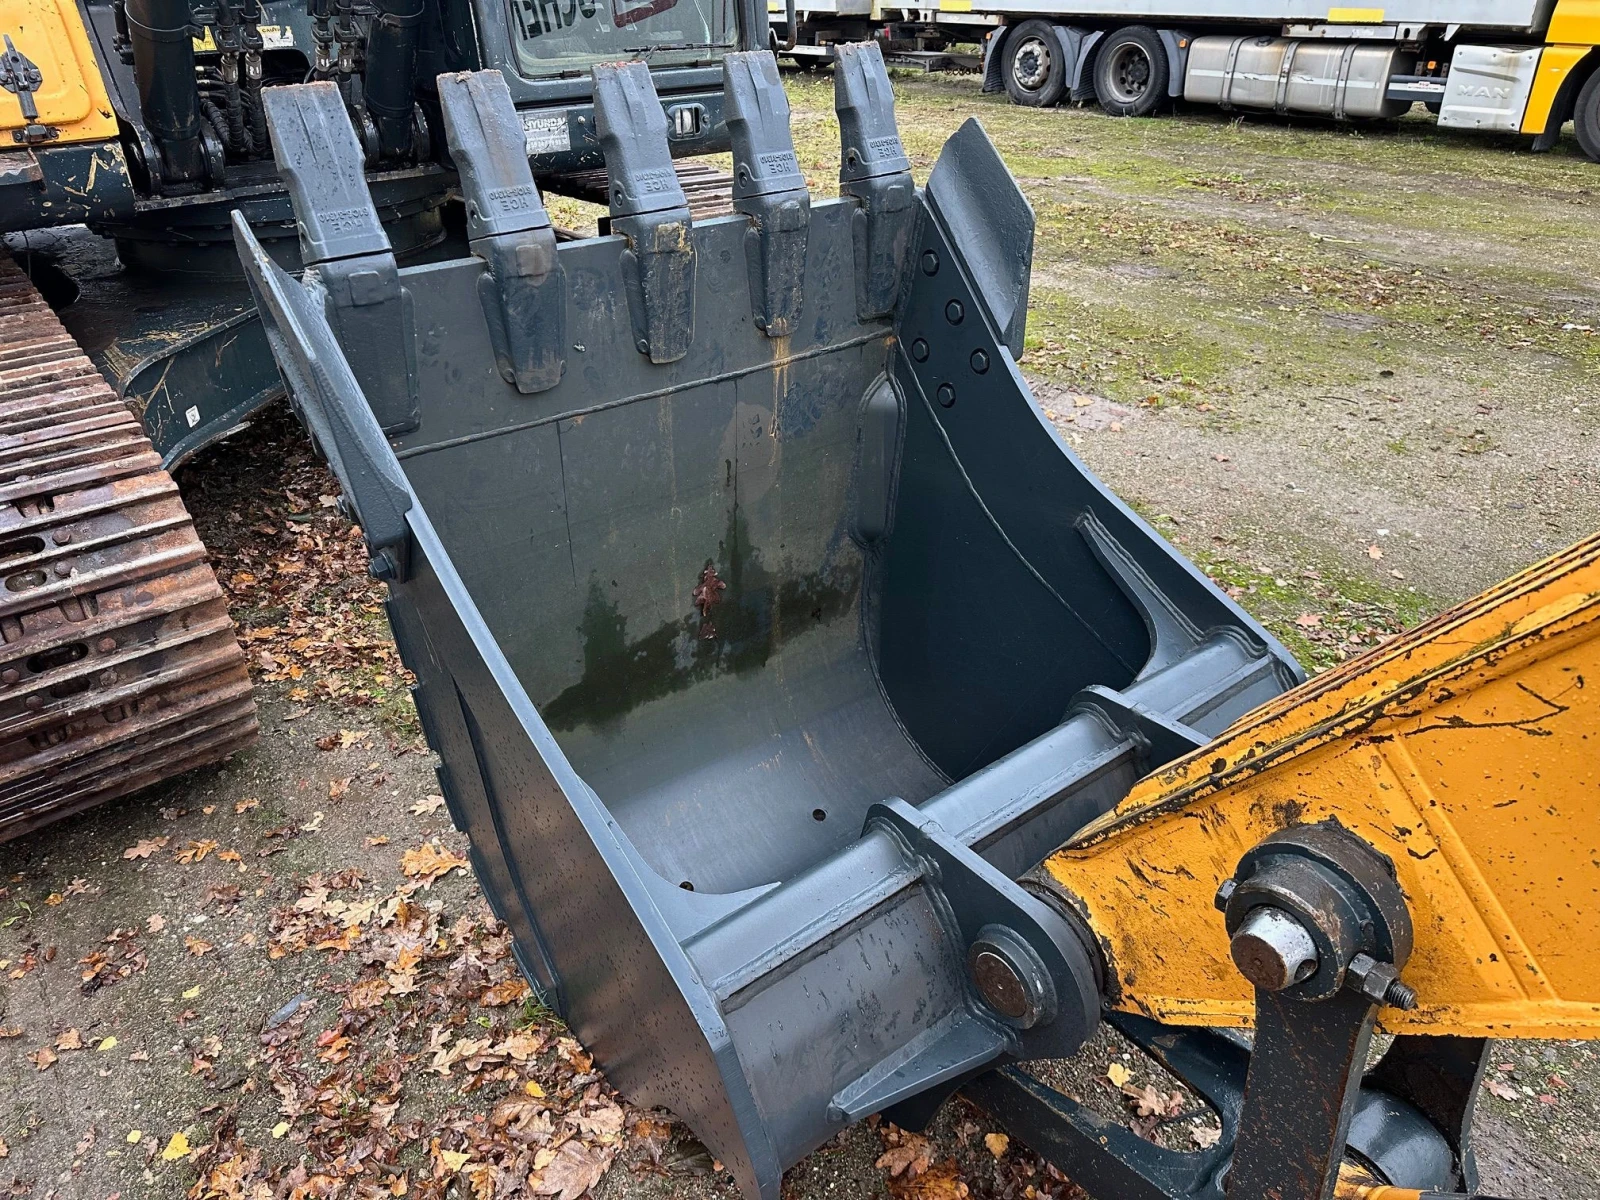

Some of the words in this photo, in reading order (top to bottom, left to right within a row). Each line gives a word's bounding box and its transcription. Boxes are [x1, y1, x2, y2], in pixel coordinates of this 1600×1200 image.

[1457, 85, 1511, 99] MAN
[877, 146, 898, 158] HCE
[768, 161, 792, 174] HCE
[643, 179, 670, 192] HCE
[500, 196, 530, 212] HCE
[332, 218, 365, 234] HCE
